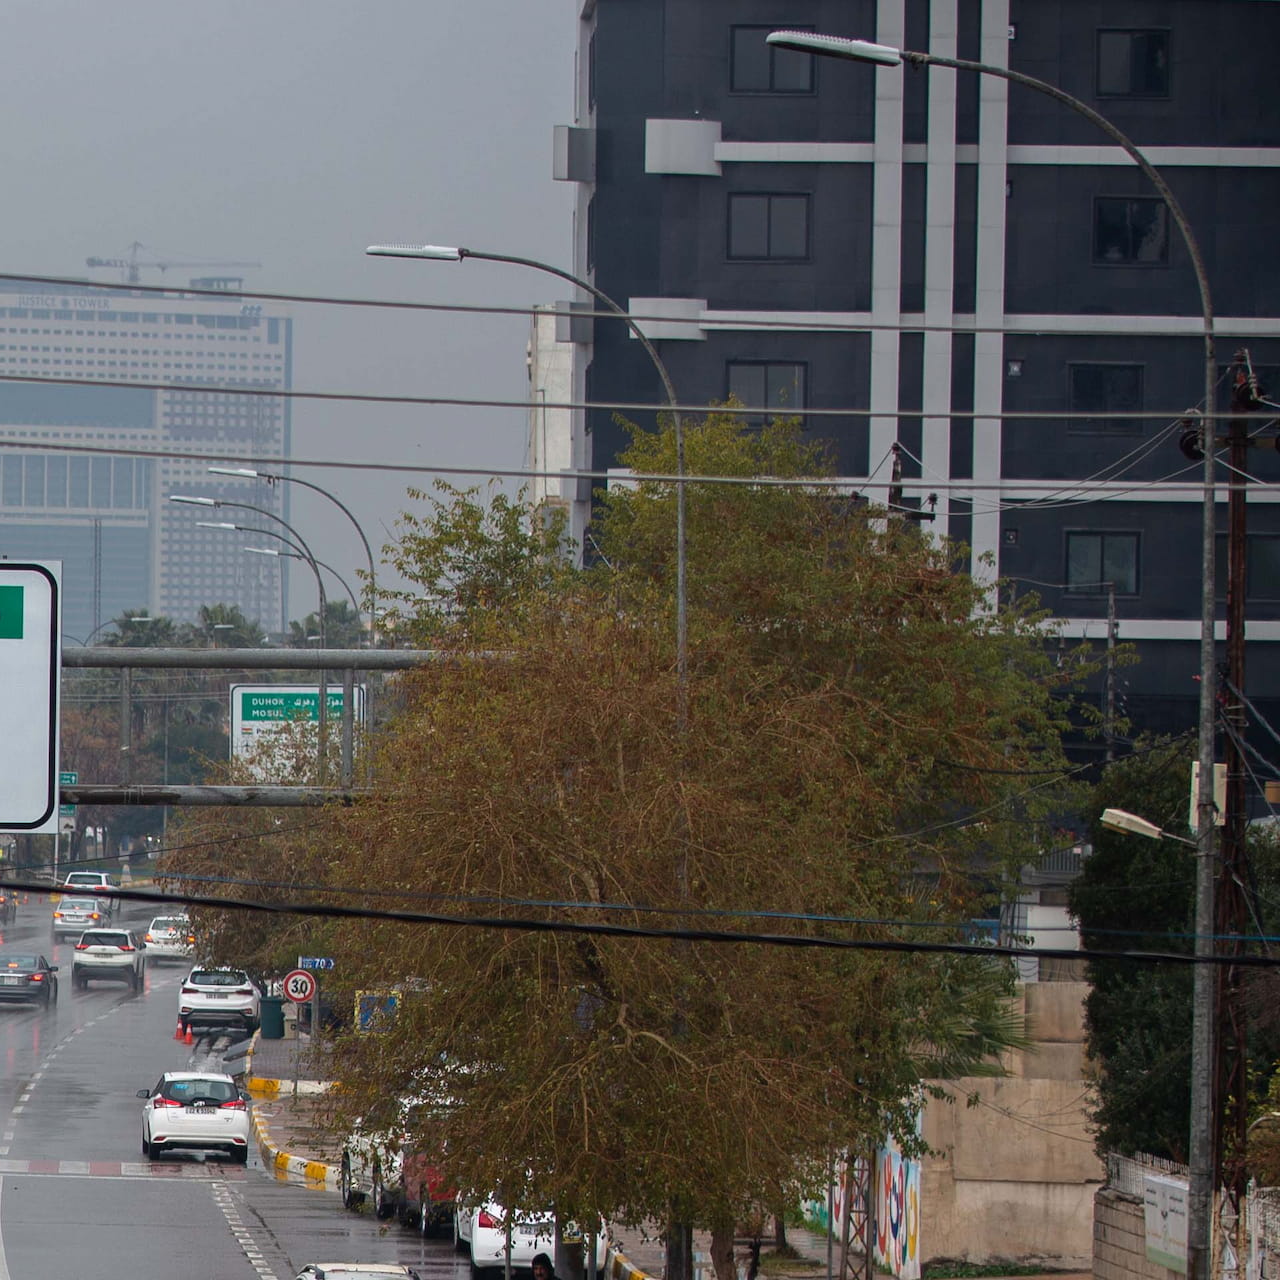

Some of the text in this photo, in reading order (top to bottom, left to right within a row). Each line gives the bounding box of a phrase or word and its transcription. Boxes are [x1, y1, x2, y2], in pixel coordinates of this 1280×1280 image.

[17, 295, 110, 309] JUSTICE TOWER
[252, 698, 284, 706] DUHOK
[252, 709, 284, 717] MOSUL
[291, 978, 308, 994] 30
